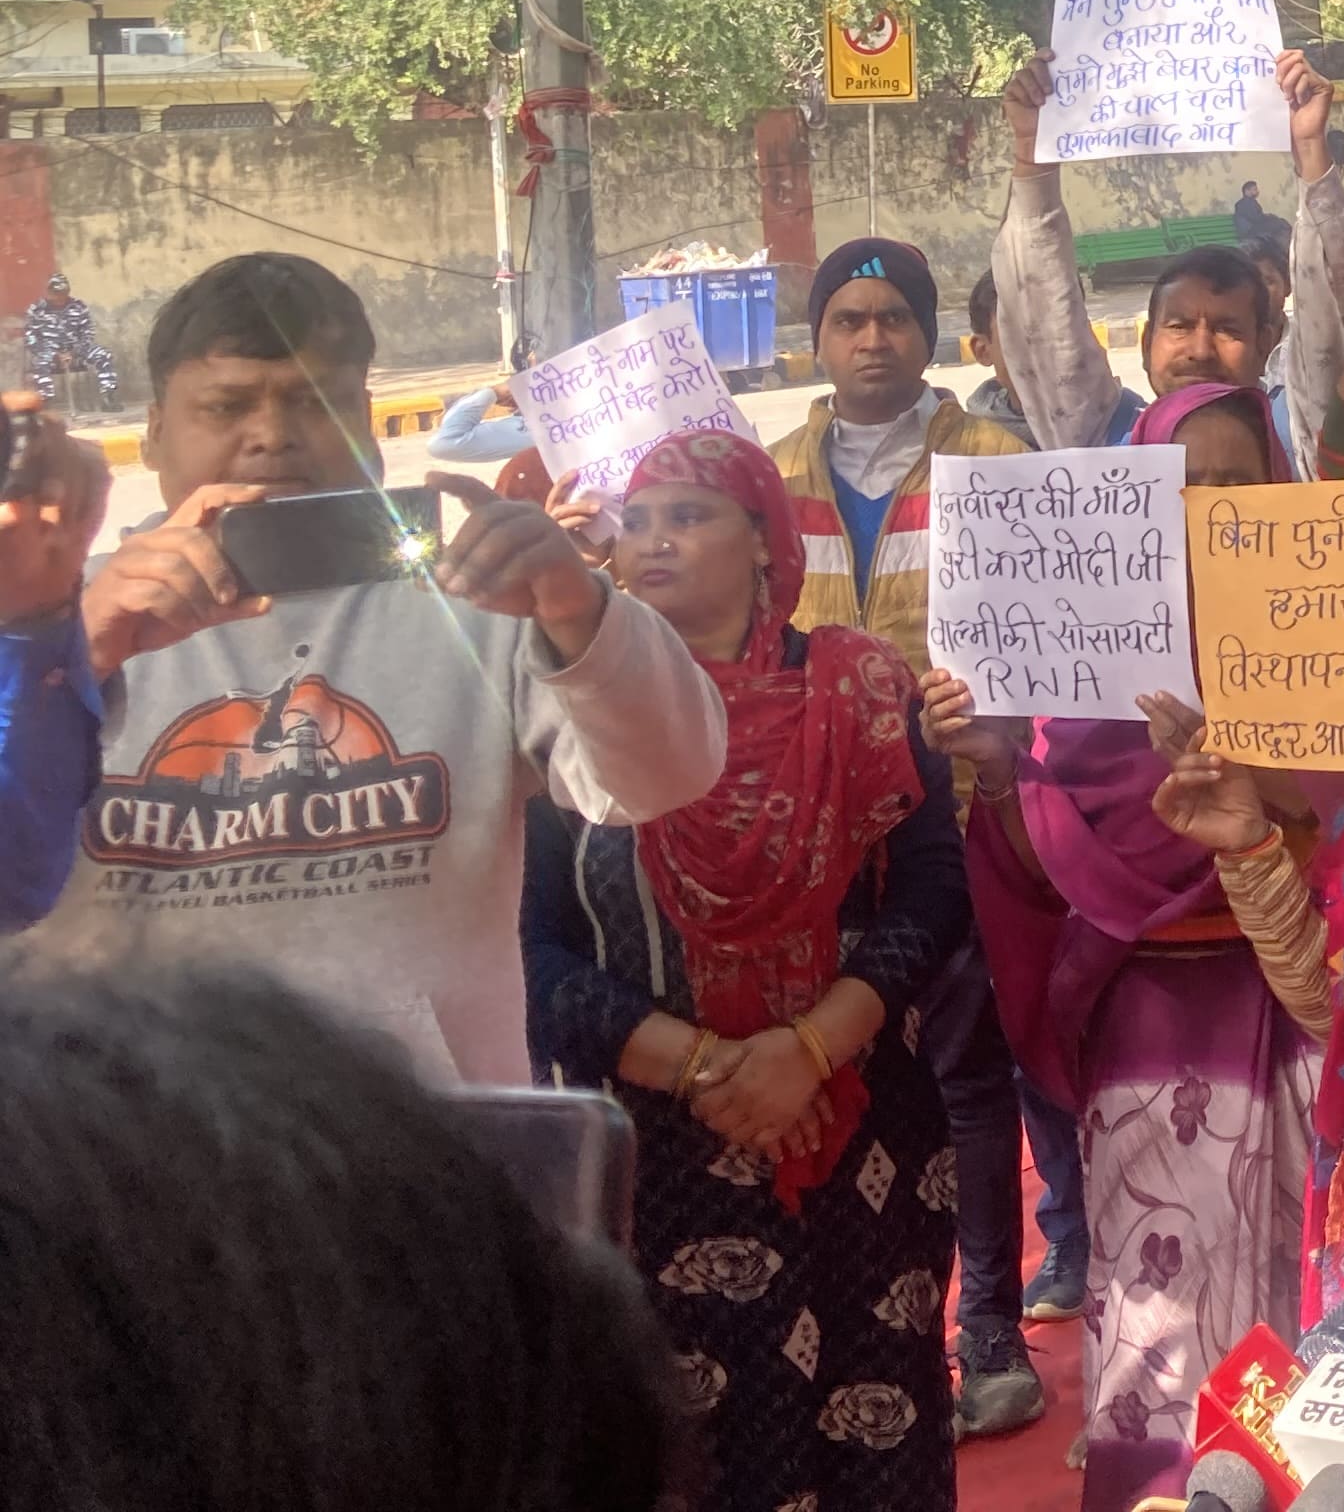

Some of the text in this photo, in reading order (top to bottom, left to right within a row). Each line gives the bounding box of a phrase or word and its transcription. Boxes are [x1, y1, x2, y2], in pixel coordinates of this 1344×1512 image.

[845, 77, 900, 91] Parking
[860, 64, 880, 76] No
[614, 336, 659, 371] नाम
[659, 322, 696, 361] पर
[1034, 467, 1082, 520] की
[985, 521, 1178, 588] करो मोदी जी
[1207, 499, 1280, 558] बिना
[1046, 597, 1174, 656] सोसायटी
[1209, 719, 1309, 760] मजदूर
[100, 774, 425, 852] CHARM CITY
[95, 845, 437, 897] ATLANTIC COAST
[213, 872, 432, 908] BASKETBALL SERIES
